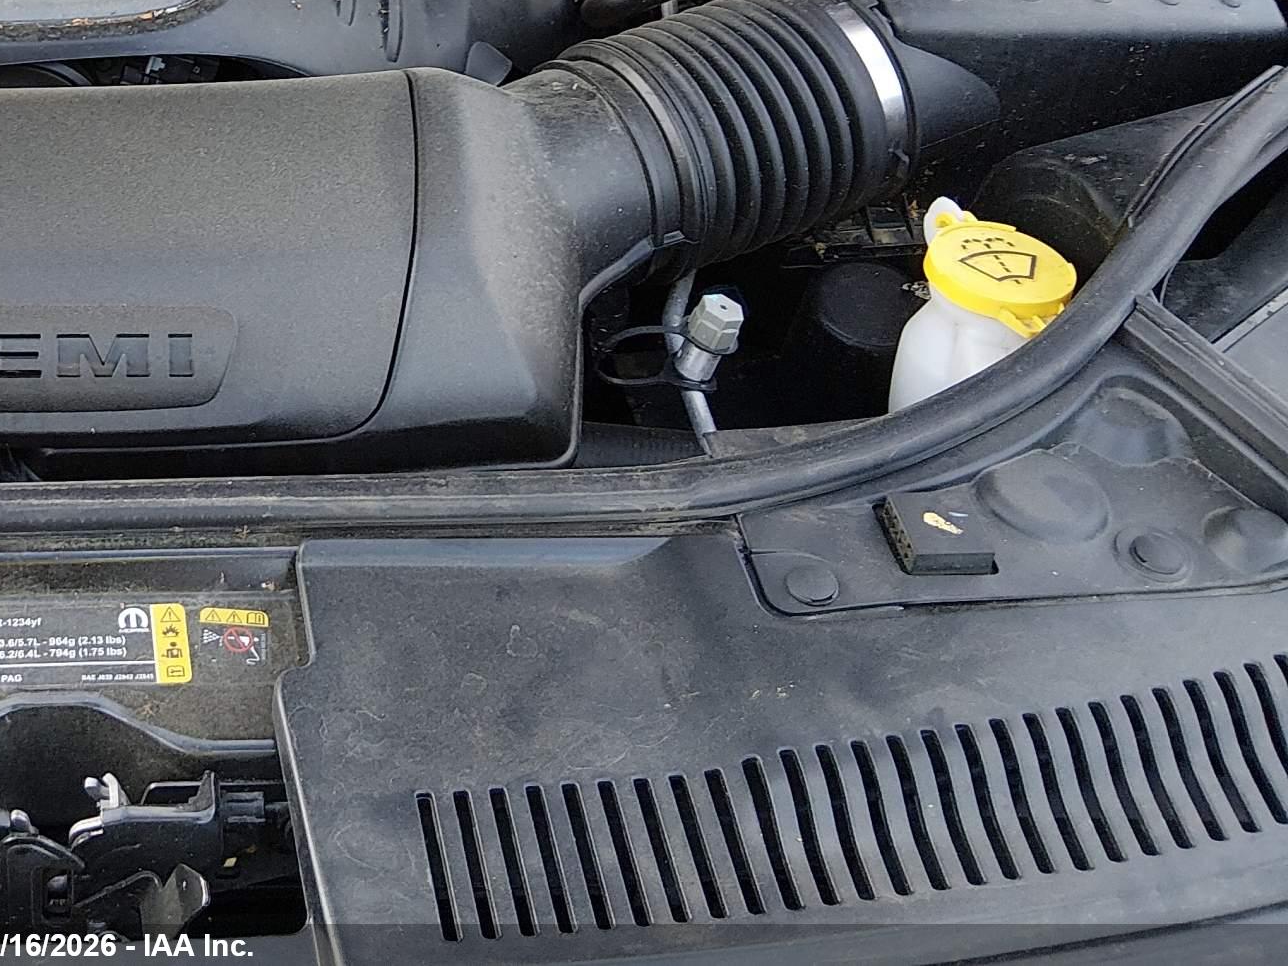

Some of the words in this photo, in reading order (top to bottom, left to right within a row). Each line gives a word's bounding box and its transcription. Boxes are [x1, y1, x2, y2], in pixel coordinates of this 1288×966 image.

[78, 635, 103, 647] (2.13
[105, 635, 126, 646] lbs)
[78, 647, 104, 658] (1.75
[106, 647, 127, 658] lbs)
[1, 674, 23, 683] PAG
